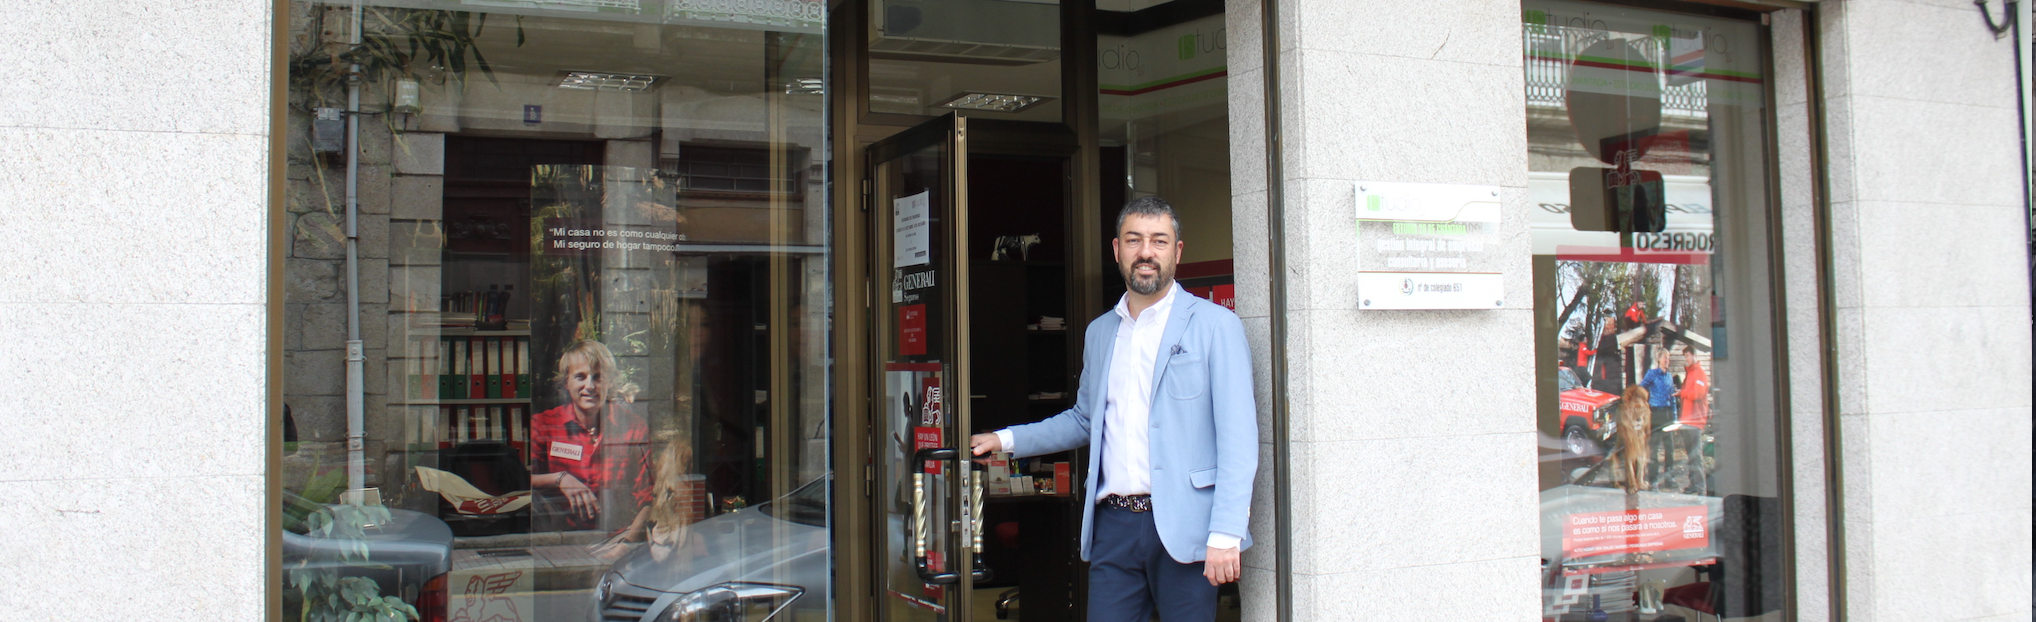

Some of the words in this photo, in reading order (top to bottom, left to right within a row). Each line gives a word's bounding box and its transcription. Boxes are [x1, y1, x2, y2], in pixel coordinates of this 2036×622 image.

[568, 229, 590, 237] casa
[620, 230, 643, 238] como
[645, 231, 678, 241] cualquier
[553, 240, 566, 249] Mi
[568, 241, 600, 250] seguro
[602, 241, 614, 249] de
[616, 241, 641, 251] hogar
[1377, 236, 1404, 253] gestión
[1406, 238, 1436, 253] integral
[1437, 238, 1446, 251] de
[1388, 254, 1427, 268] consultoría
[1436, 253, 1466, 268] asesoría
[903, 270, 935, 291] GENERALI
[1424, 282, 1430, 292] de
[1430, 282, 1452, 293] colegiado
[1453, 282, 1463, 292] 651
[904, 291, 920, 304] Seguros
[1561, 401, 1589, 413] GENERALI
[1573, 515, 1598, 525] Cuando
[1599, 514, 1606, 523] te
[1607, 514, 1622, 525] pasa
[1623, 513, 1637, 524] algo
[1638, 513, 1647, 521] en
[1648, 511, 1663, 521] casa
[1582, 526, 1600, 535] como
[1601, 524, 1607, 533] si
[1608, 525, 1620, 533] nos
[1621, 523, 1643, 533] pasara
[1643, 523, 1649, 531] a
[1649, 520, 1678, 530] nosotros.
[1683, 532, 1704, 540] GENERALI
